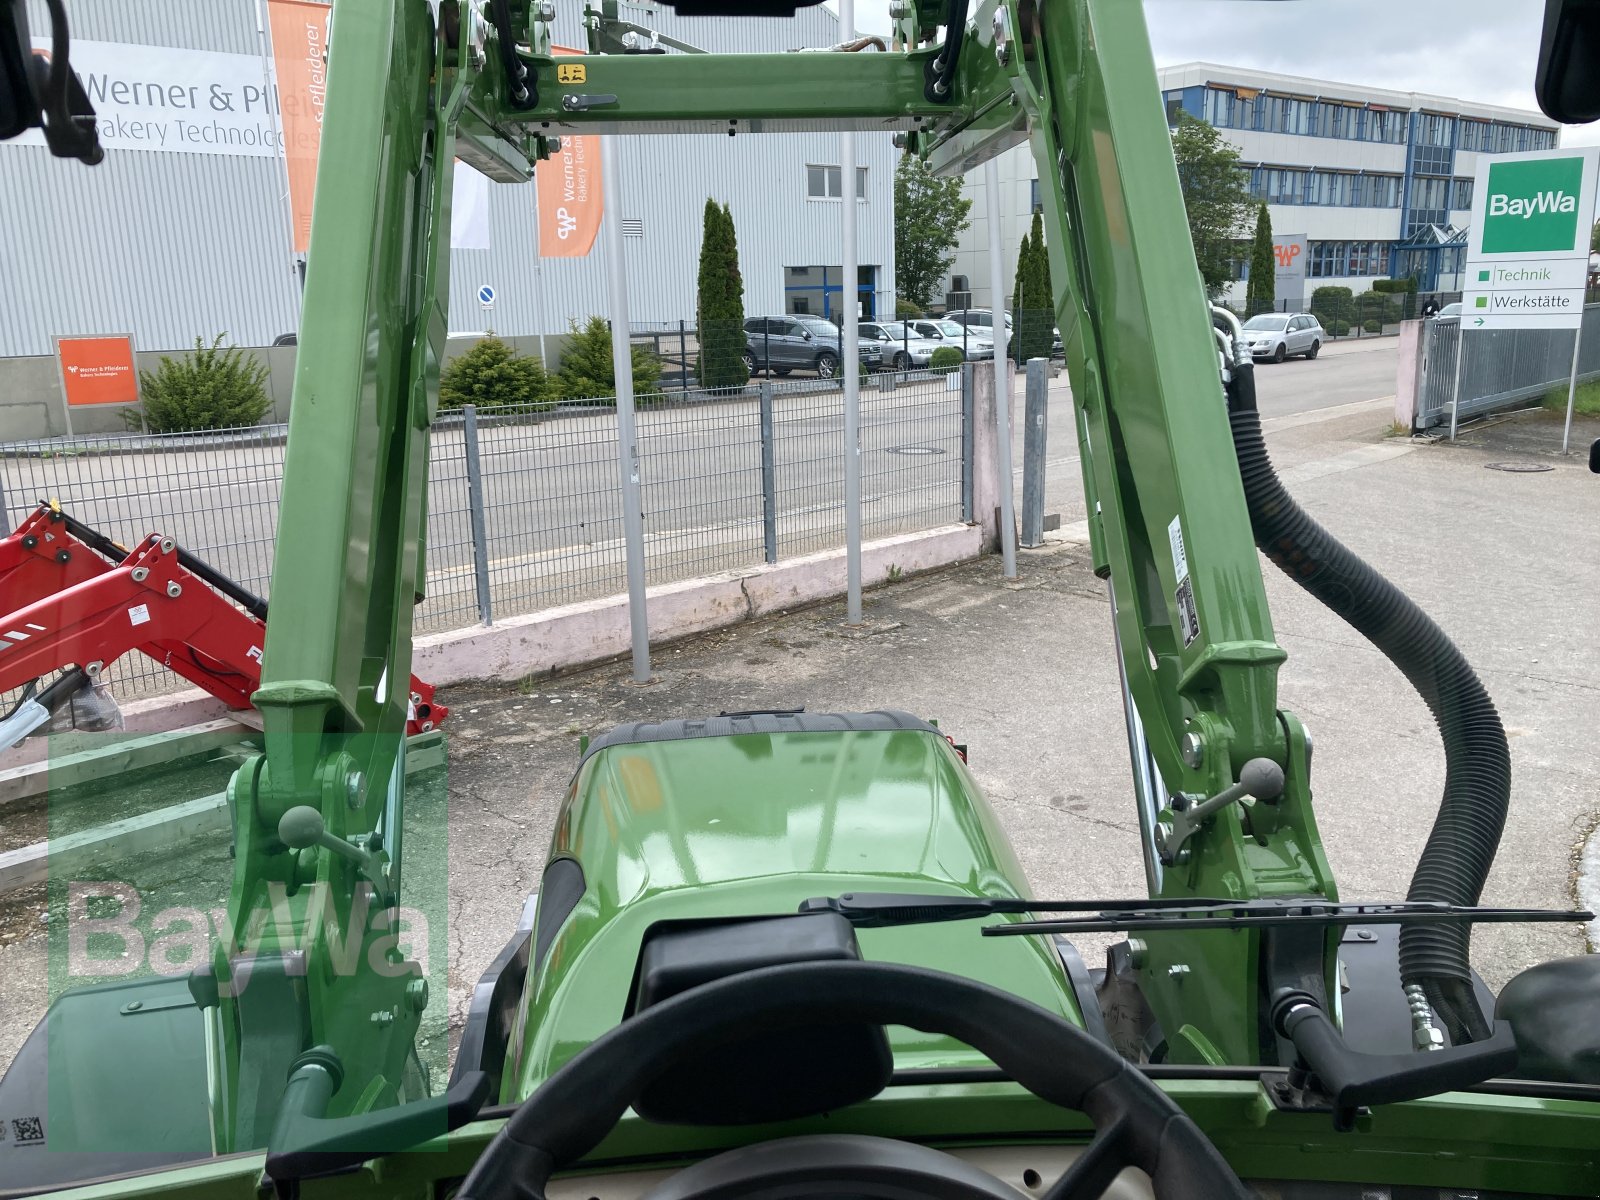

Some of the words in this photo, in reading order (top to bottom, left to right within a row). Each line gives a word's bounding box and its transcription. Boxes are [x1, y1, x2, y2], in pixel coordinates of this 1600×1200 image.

[306, 22, 324, 105] Pfleiderer
[75, 72, 198, 109] Werner
[209, 83, 236, 113] &
[95, 113, 167, 146] akery
[575, 135, 584, 164] Techn
[563, 151, 575, 202] Werner
[577, 167, 588, 203] Bakery
[1489, 190, 1576, 219] BayWa
[1497, 267, 1552, 281] Technik
[1494, 294, 1570, 308] Werkstätte
